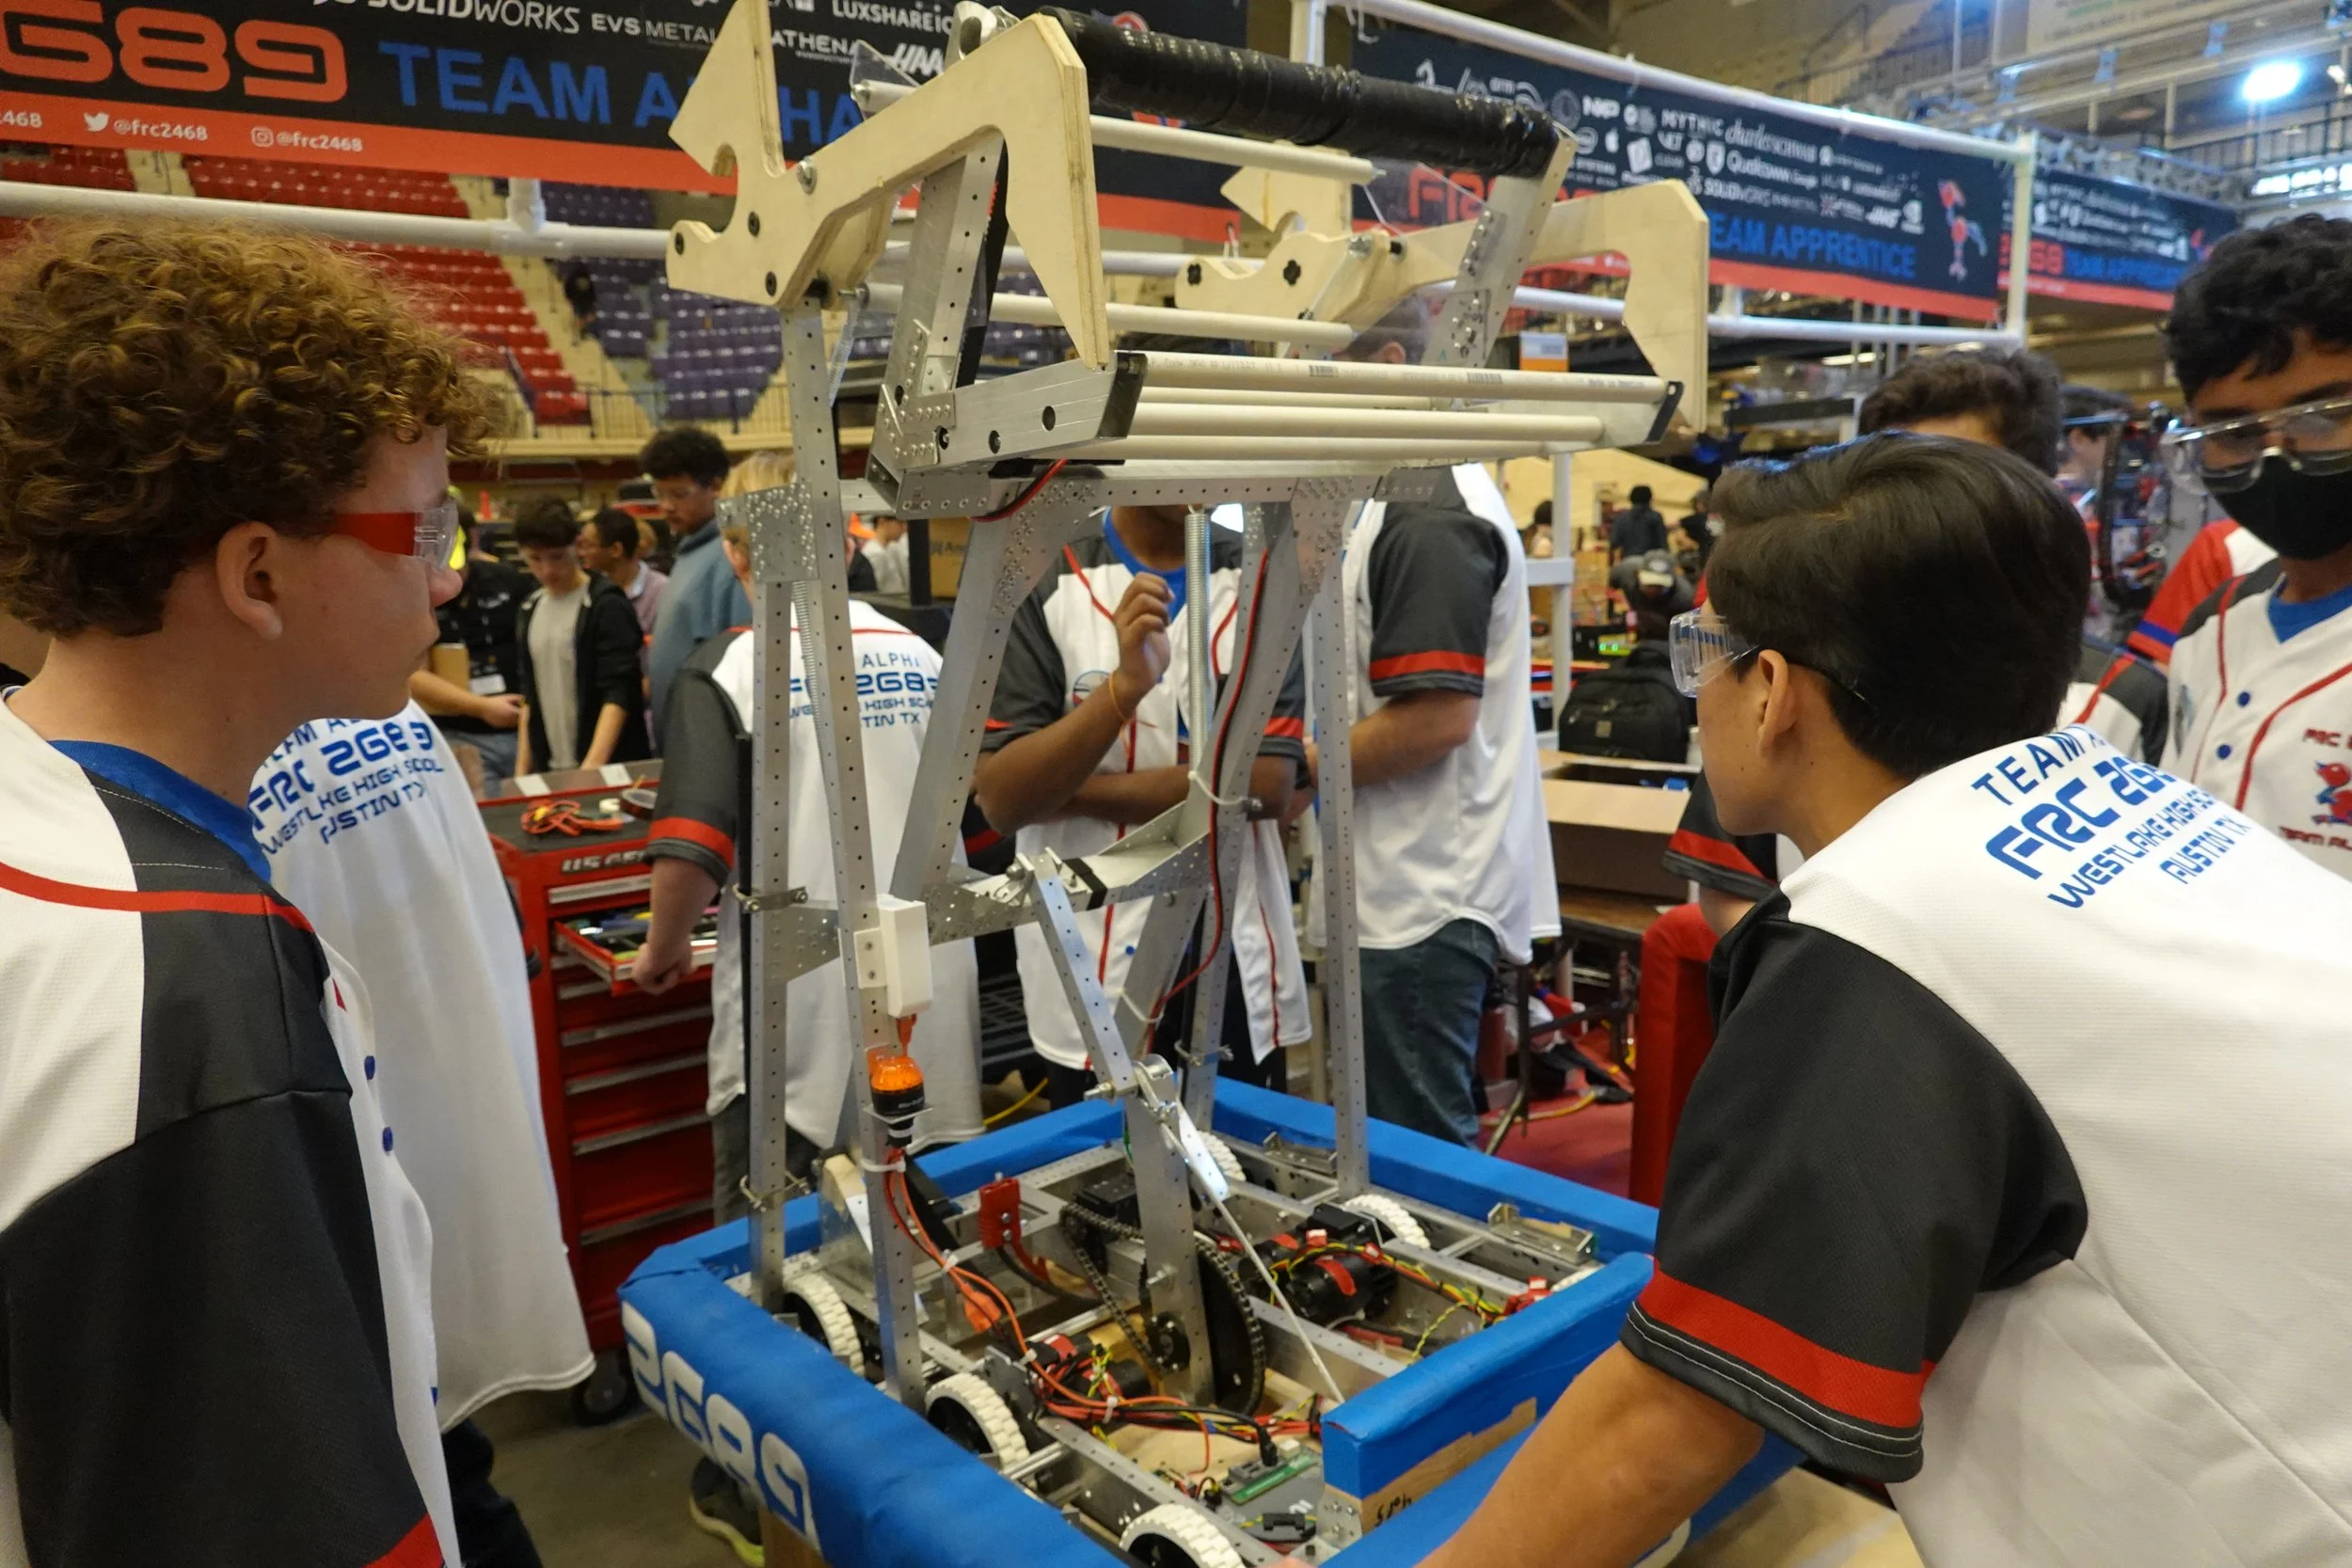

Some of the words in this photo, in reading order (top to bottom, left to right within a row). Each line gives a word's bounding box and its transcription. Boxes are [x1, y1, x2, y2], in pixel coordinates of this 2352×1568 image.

[591, 13, 642, 36] EVS
[833, 0, 934, 32] LUXSHARE
[378, 40, 612, 124] TEAM
[0, 110, 42, 129] 468
[113, 114, 209, 141] @frc2468
[277, 133, 363, 152] @frc2468
[1709, 210, 1767, 256] EAM
[1771, 226, 1917, 279] APPRENTICE
[861, 714, 895, 729] TIN
[900, 712, 921, 725] TX
[865, 698, 905, 712] HIGH
[1971, 732, 2086, 806] TEAM
[1985, 777, 2122, 880] FRC
[2047, 815, 2174, 909] WESTLAKE
[2159, 826, 2236, 885] AUSTIN
